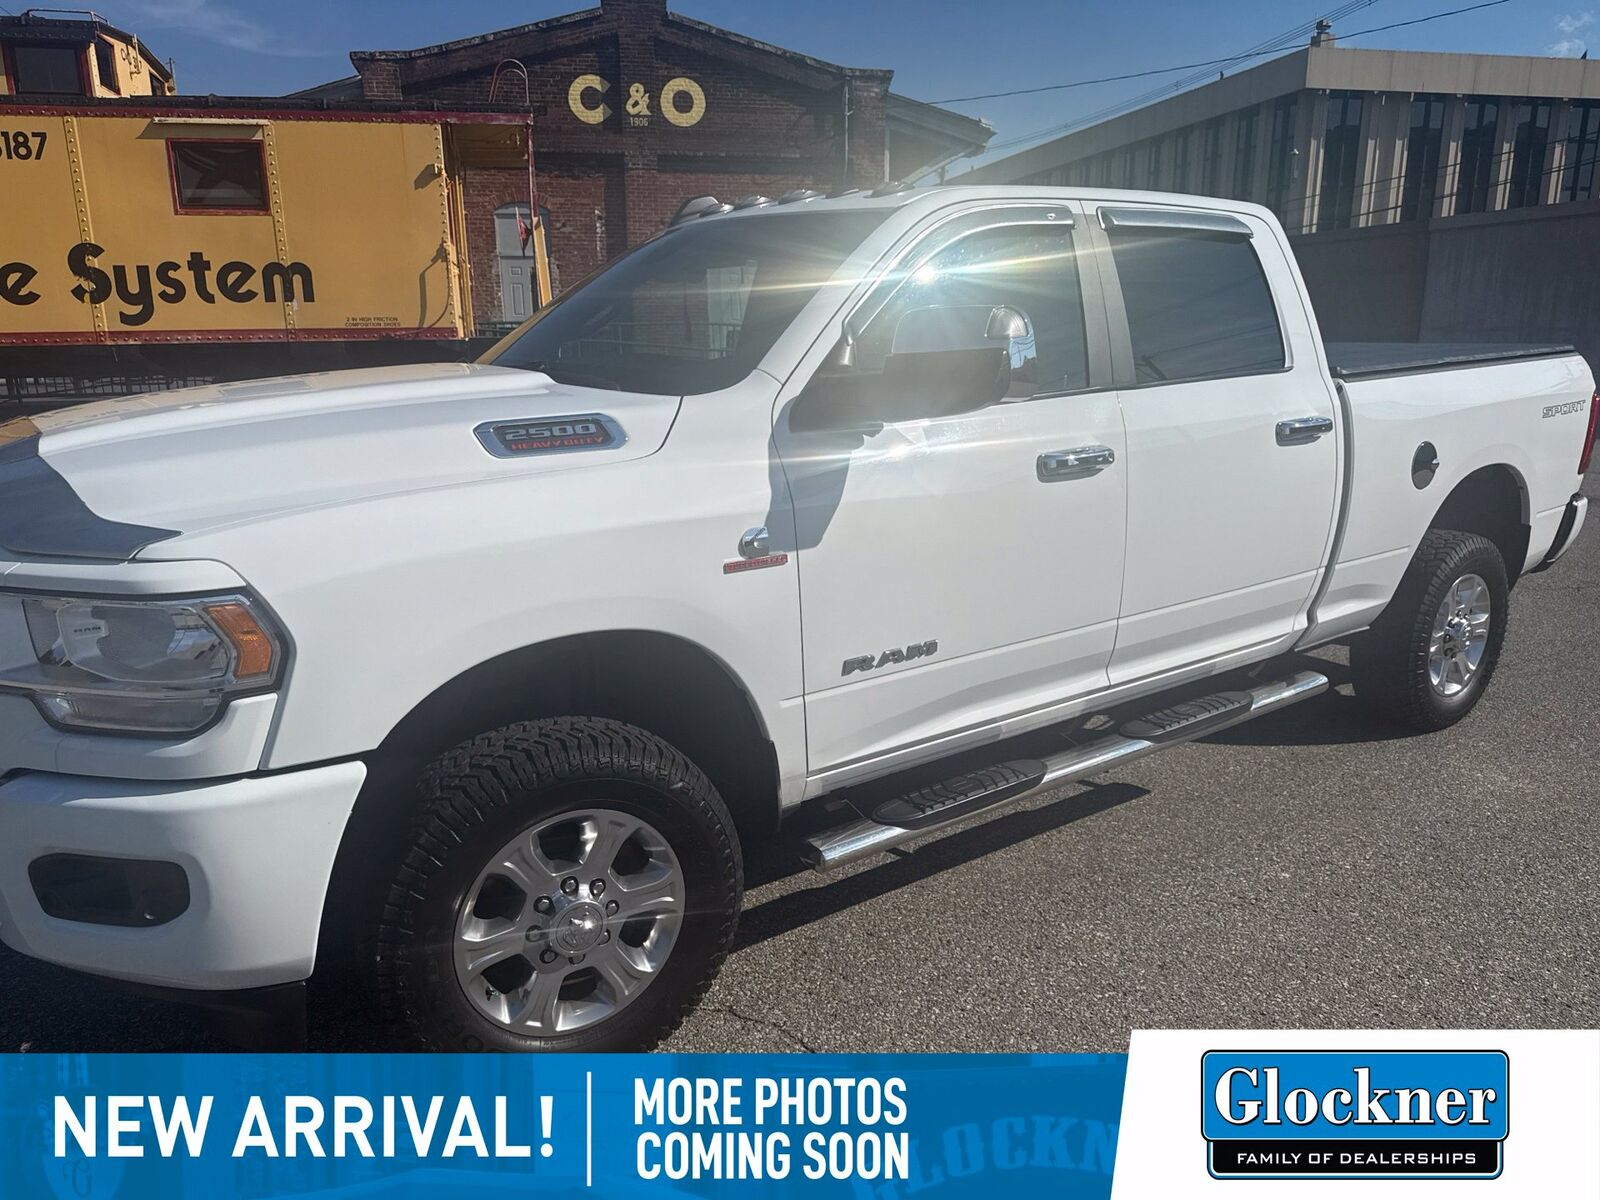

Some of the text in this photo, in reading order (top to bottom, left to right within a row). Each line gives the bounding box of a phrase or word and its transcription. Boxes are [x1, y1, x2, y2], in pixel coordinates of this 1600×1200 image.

[568, 74, 706, 127] C & O
[629, 117, 649, 127] 1906
[0, 131, 47, 160] 187
[68, 243, 315, 326] System
[1542, 400, 1586, 418] SPORT
[505, 424, 597, 441] 2500
[511, 439, 562, 450] HEAVY
[841, 639, 939, 676] RAM
